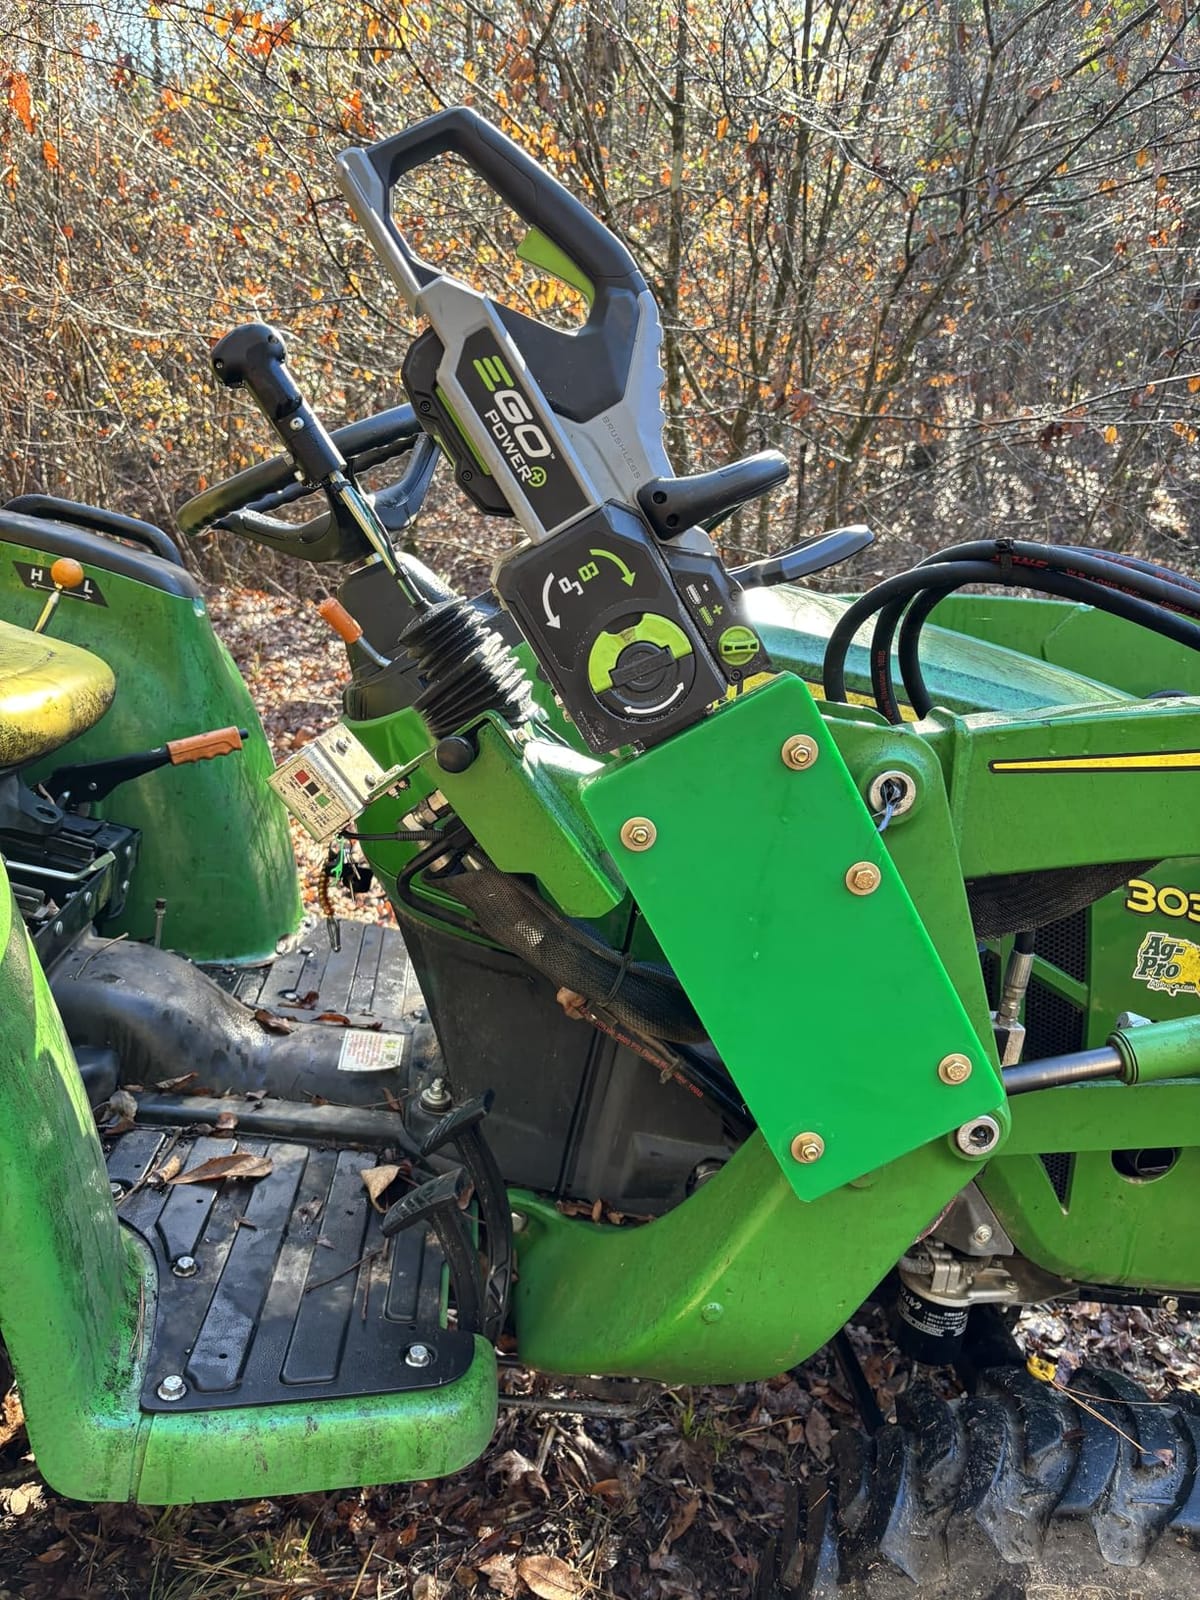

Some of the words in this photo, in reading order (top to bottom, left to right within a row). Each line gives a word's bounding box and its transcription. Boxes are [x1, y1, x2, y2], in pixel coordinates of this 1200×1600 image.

[473, 355, 552, 459] EGO
[31, 568, 43, 582] H
[84, 580, 94, 594] L
[1143, 936, 1185, 960] Ag-
[1138, 957, 1180, 979] Pro
